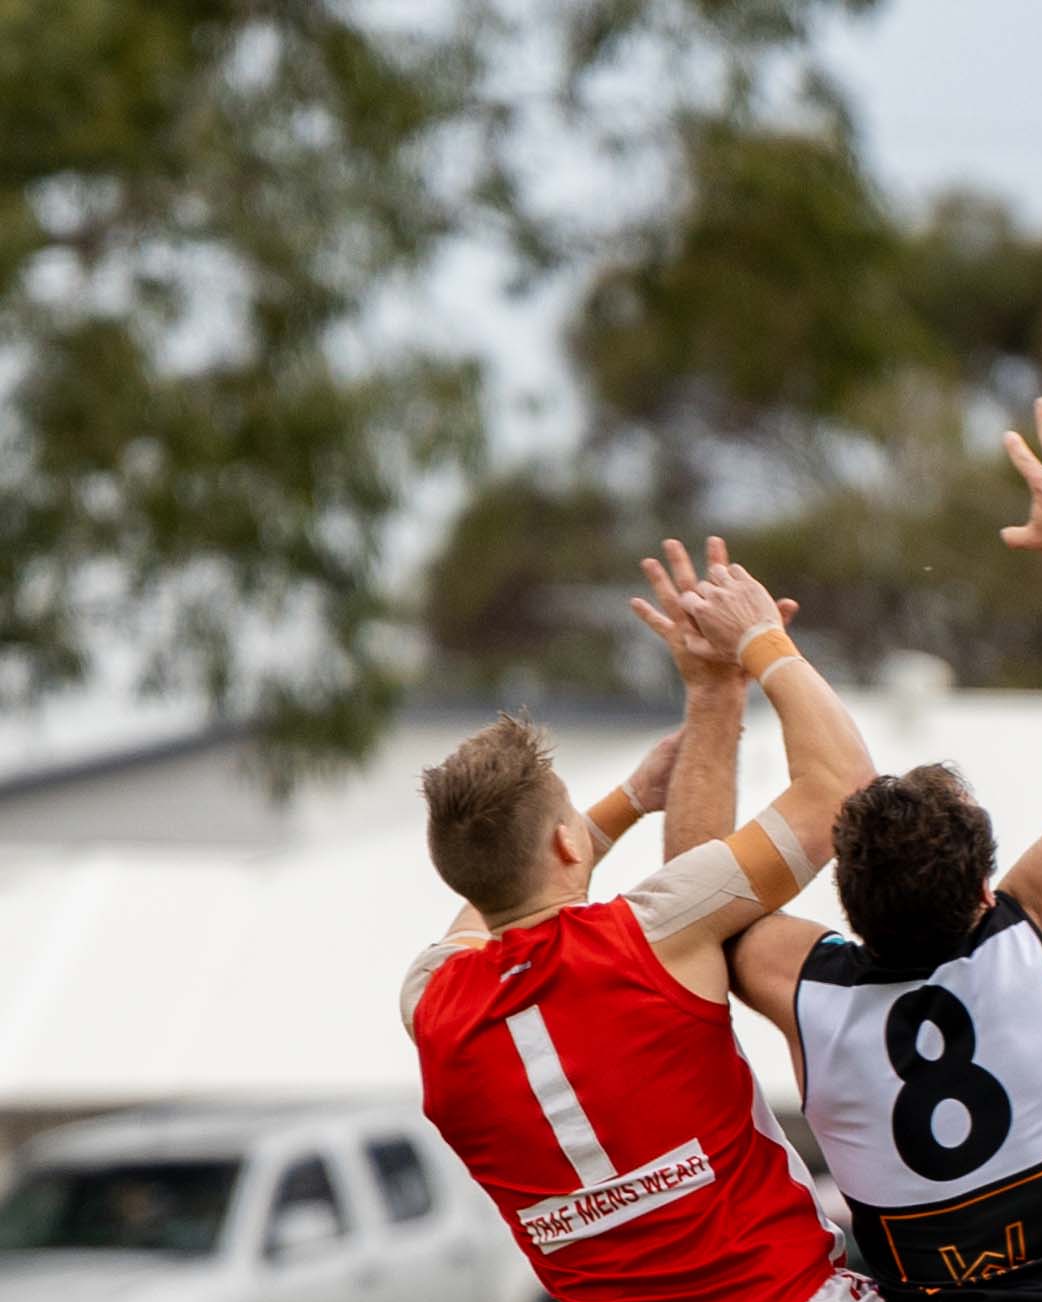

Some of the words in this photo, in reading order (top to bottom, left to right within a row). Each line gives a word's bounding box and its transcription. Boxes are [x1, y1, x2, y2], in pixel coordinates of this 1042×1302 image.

[506, 1004, 617, 1187] 1
[886, 984, 1013, 1181] 8
[574, 1181, 640, 1226] MENS
[638, 1155, 707, 1195] WEAR
